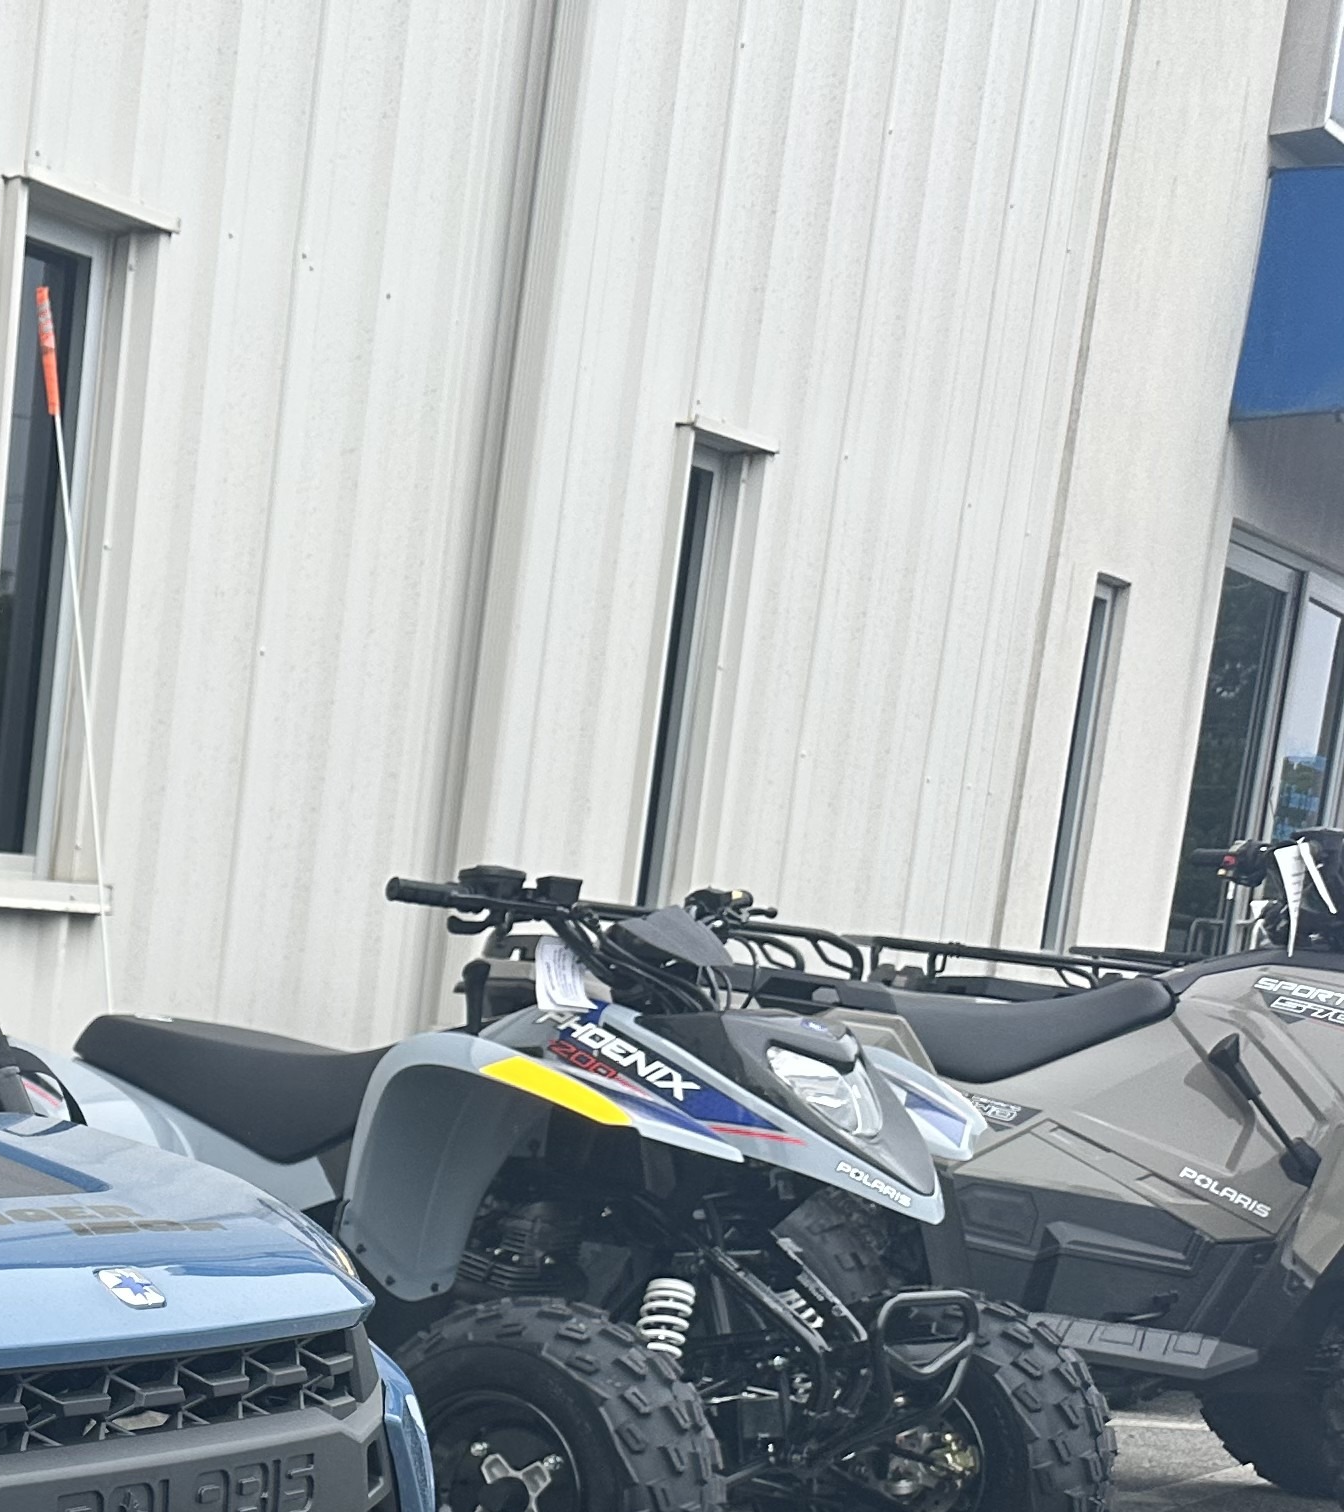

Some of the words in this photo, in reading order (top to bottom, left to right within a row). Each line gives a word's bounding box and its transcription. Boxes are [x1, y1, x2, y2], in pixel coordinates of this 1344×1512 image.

[534, 1011, 701, 1101] PHOENIX
[548, 1039, 618, 1077] 200
[836, 1161, 912, 1208] POLARIS
[1178, 1166, 1272, 1218] POLARIS
